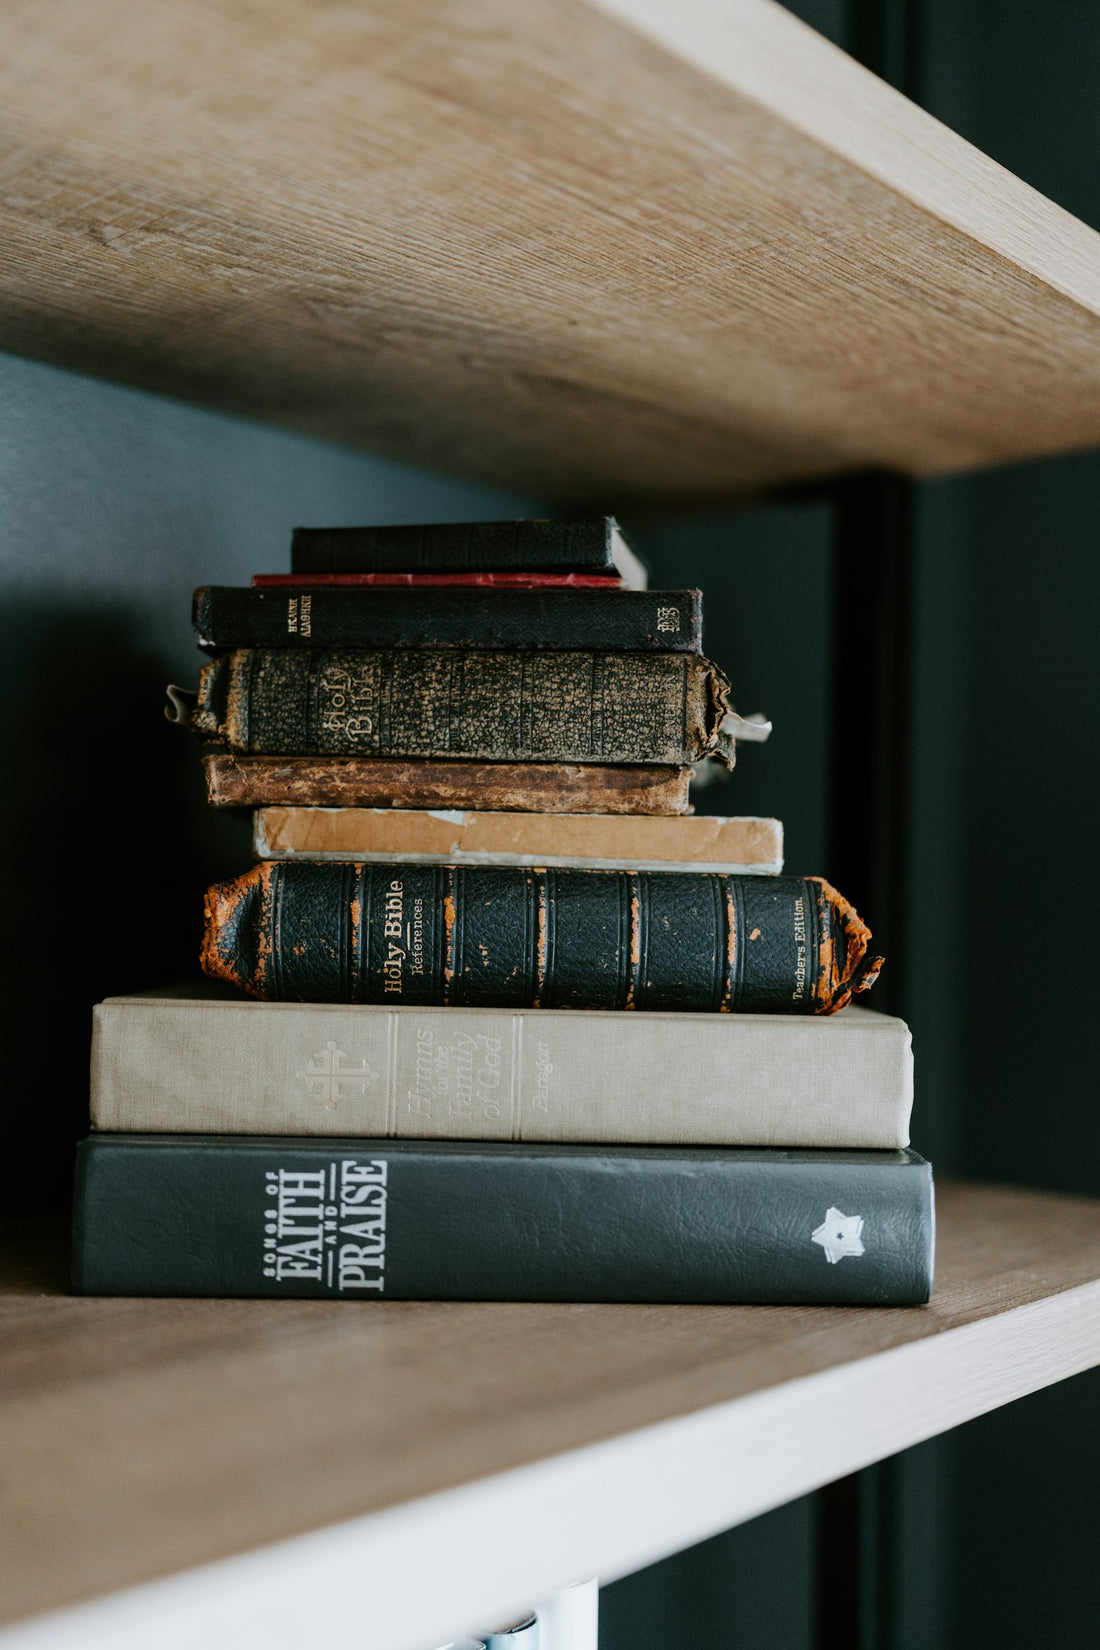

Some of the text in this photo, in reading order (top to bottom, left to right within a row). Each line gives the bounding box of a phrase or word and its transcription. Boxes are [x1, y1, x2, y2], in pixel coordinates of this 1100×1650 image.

[322, 666, 352, 732] Holy
[384, 880, 406, 994] Holy Bible
[410, 898, 424, 975] References
[792, 896, 806, 1000] Teacher's Edition.
[408, 1029, 436, 1119] Hymns
[434, 1045, 449, 1096] for the
[448, 1031, 477, 1121] Family
[477, 1033, 502, 1120] of God
[532, 1041, 554, 1112] Paragon
[262, 1171, 279, 1277] SONGS OF
[276, 1168, 325, 1282] FAITH
[324, 1205, 338, 1245] AND
[337, 1159, 388, 1292] PRAISE
